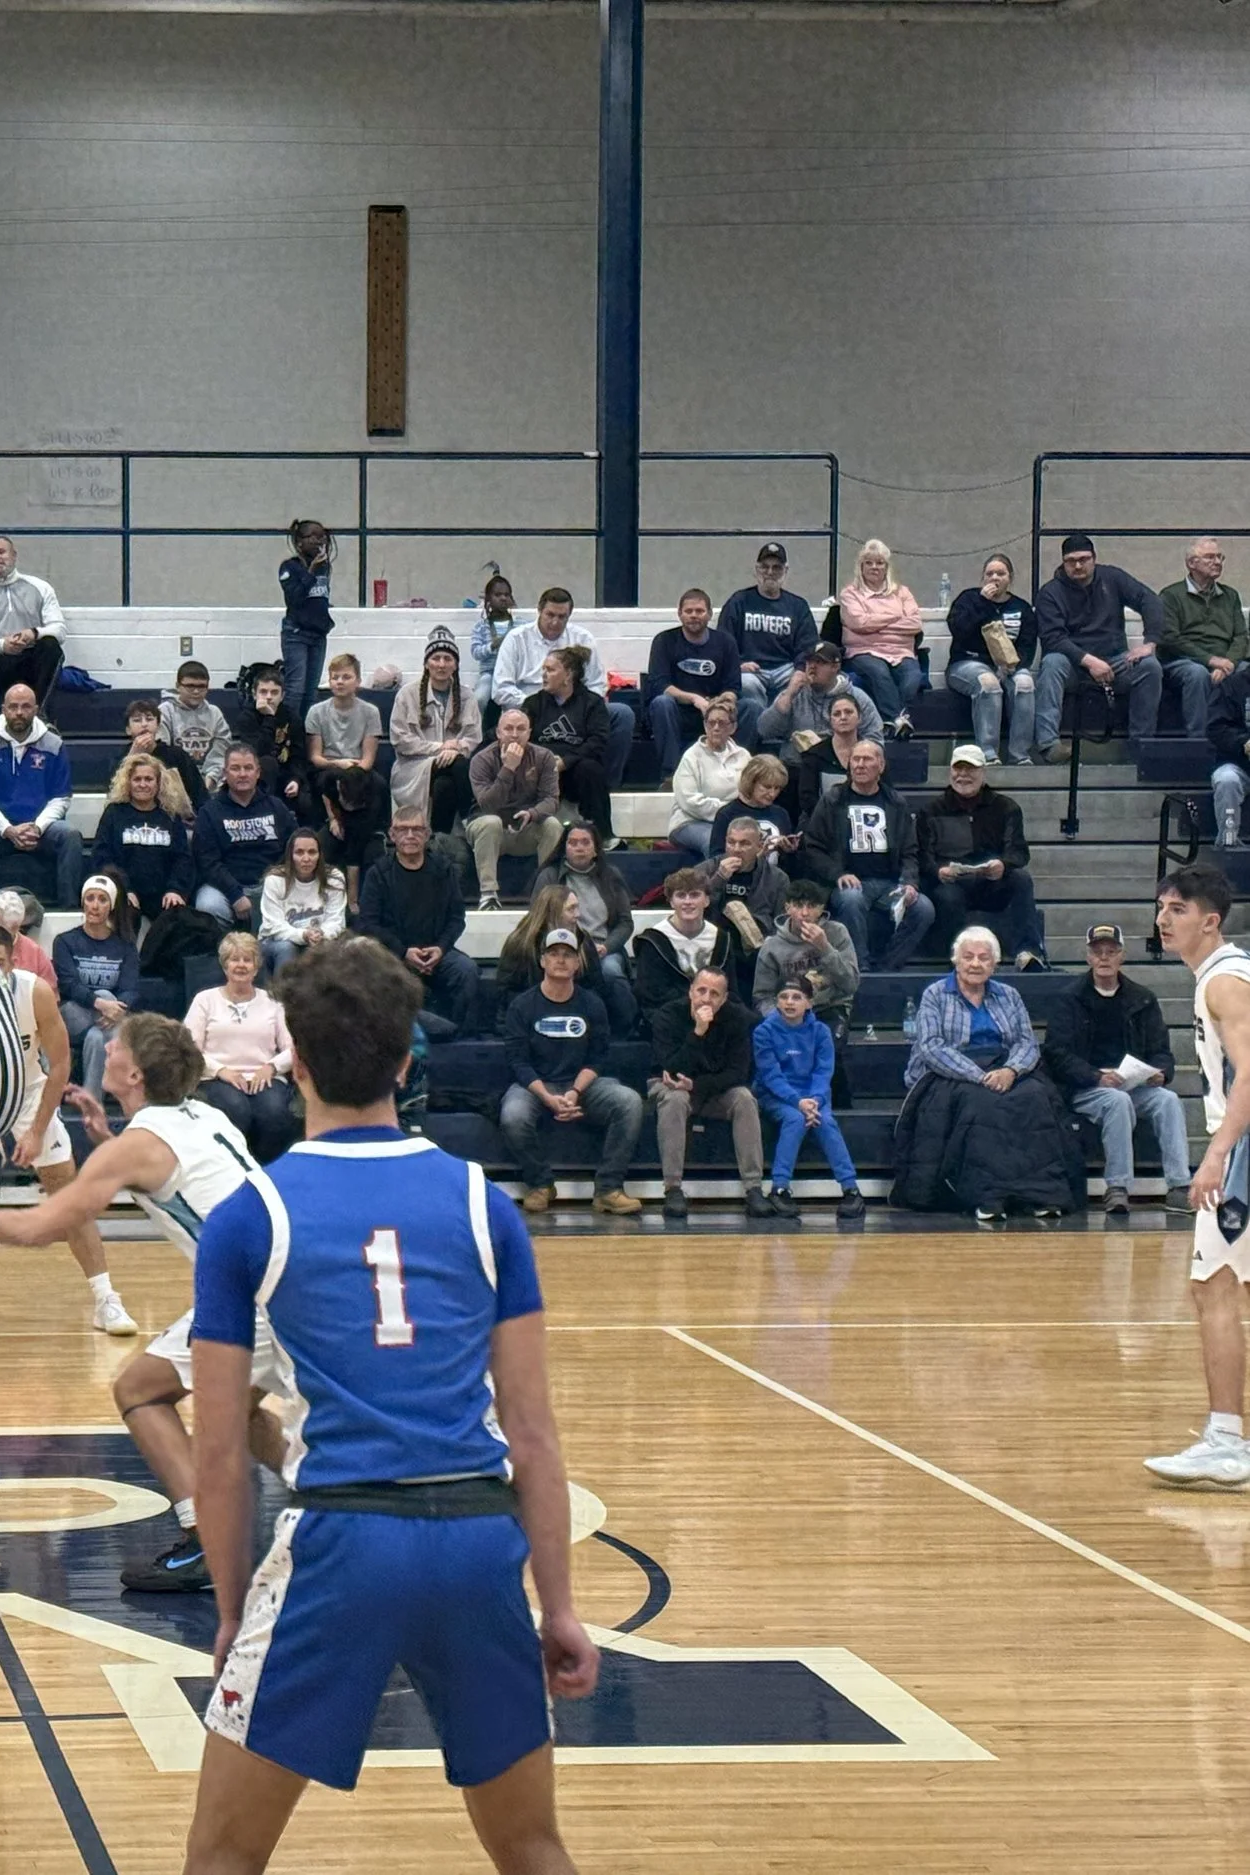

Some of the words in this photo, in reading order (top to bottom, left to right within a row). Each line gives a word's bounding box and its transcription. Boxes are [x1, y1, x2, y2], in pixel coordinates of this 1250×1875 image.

[744, 611, 792, 636] ROVERS
[848, 805, 888, 854] R
[212, 1131, 253, 1173] 1
[362, 1227, 414, 1347] 1
